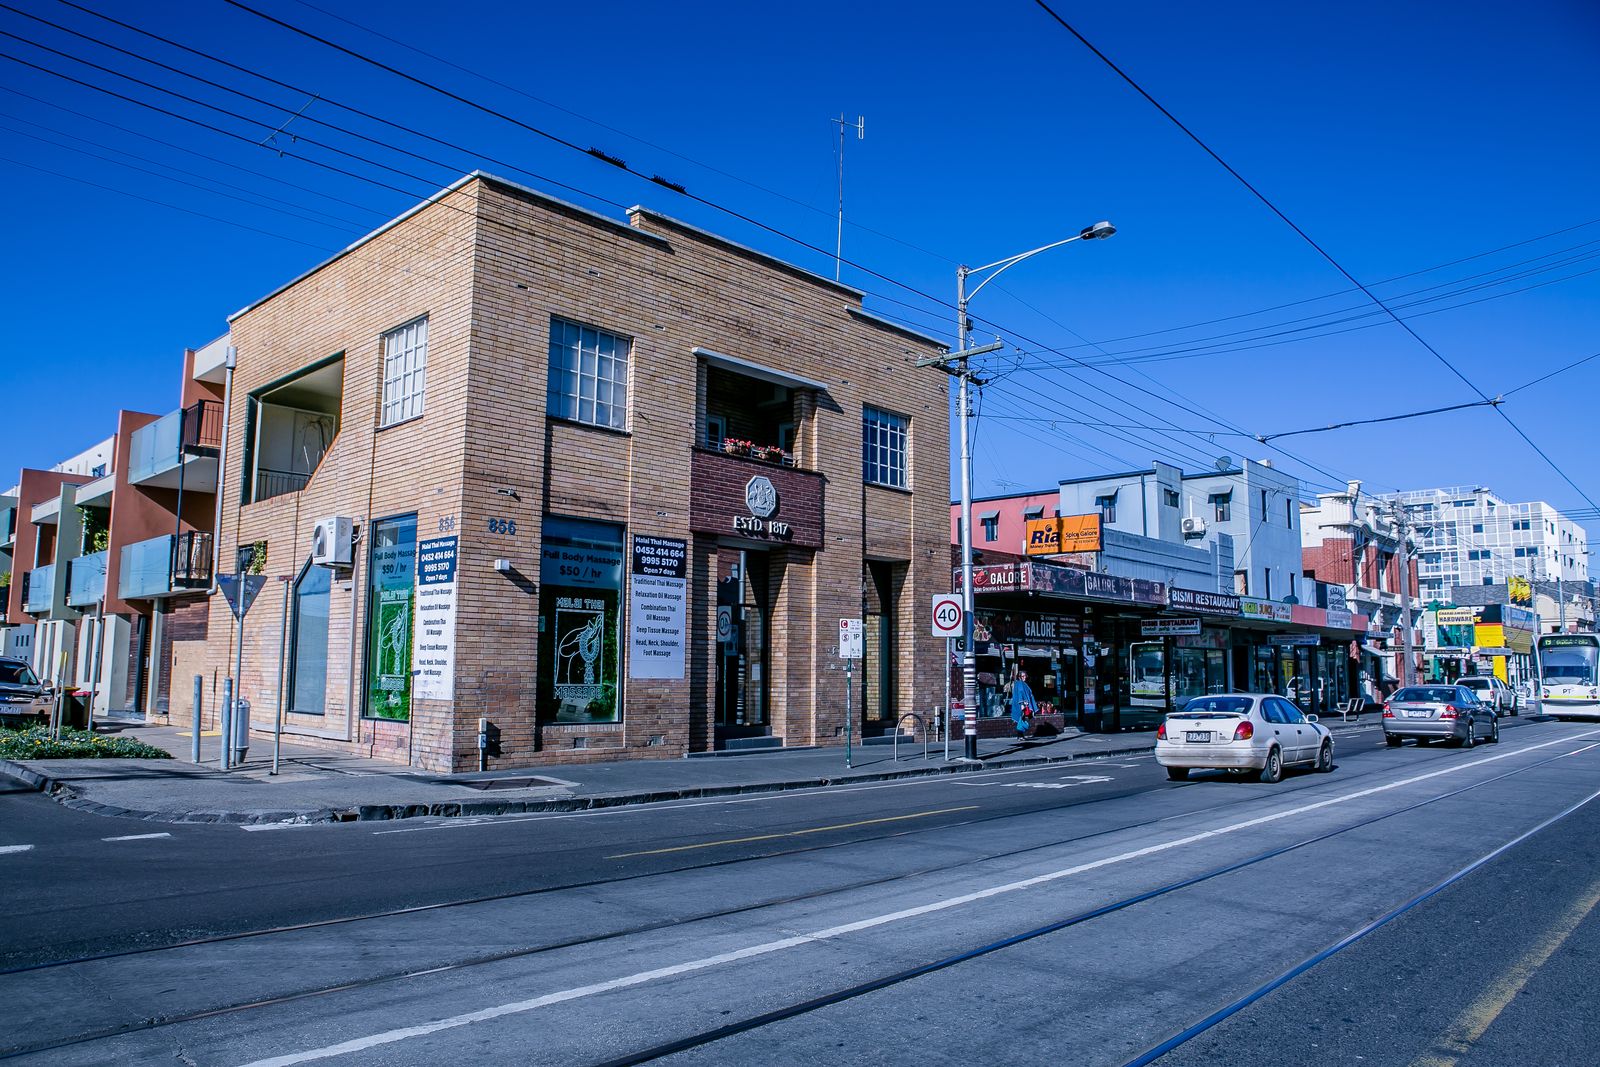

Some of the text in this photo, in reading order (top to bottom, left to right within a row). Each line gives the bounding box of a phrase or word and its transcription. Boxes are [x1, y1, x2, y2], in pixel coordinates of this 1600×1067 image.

[438, 515, 456, 531] 856
[488, 518, 517, 535] 856
[769, 521, 789, 535] 1817
[1030, 526, 1061, 545] Ria
[432, 541, 440, 549] Thai
[440, 540, 456, 549] Massage
[662, 540, 685, 548] Massage
[375, 549, 417, 562] Full Body Massag
[421, 550, 454, 562] 0452 414 664
[635, 546, 684, 558] 0452 414 664
[543, 550, 621, 567] Full Body Massage
[641, 556, 678, 567] 9995 5170
[381, 565, 394, 575] $50
[400, 563, 407, 573] hr
[424, 562, 450, 573] 9995 5170
[559, 565, 580, 577] $50
[591, 567, 603, 579] hr
[643, 566, 659, 575] Open
[662, 568, 676, 576] days
[438, 573, 448, 581] days
[990, 571, 1027, 585] GALORE
[634, 578, 684, 589] Traditional Thai Massage
[1087, 577, 1117, 594] GALORE
[440, 589, 453, 597] Massage
[635, 590, 658, 598] Relaxation
[664, 593, 682, 601] Massage
[1171, 591, 1194, 604] BISMI
[1195, 594, 1240, 609] RESTAURANT
[438, 603, 451, 612] Massage
[640, 603, 667, 611] Combination
[652, 615, 671, 623] Massage
[938, 608, 957, 623] 40
[432, 629, 443, 637] Massage
[636, 626, 648, 634] Deep
[661, 627, 679, 636] Massage
[1025, 620, 1056, 638] GALORE
[435, 644, 448, 652] Massage
[652, 650, 671, 658] Massage
[429, 669, 442, 677] Massage
